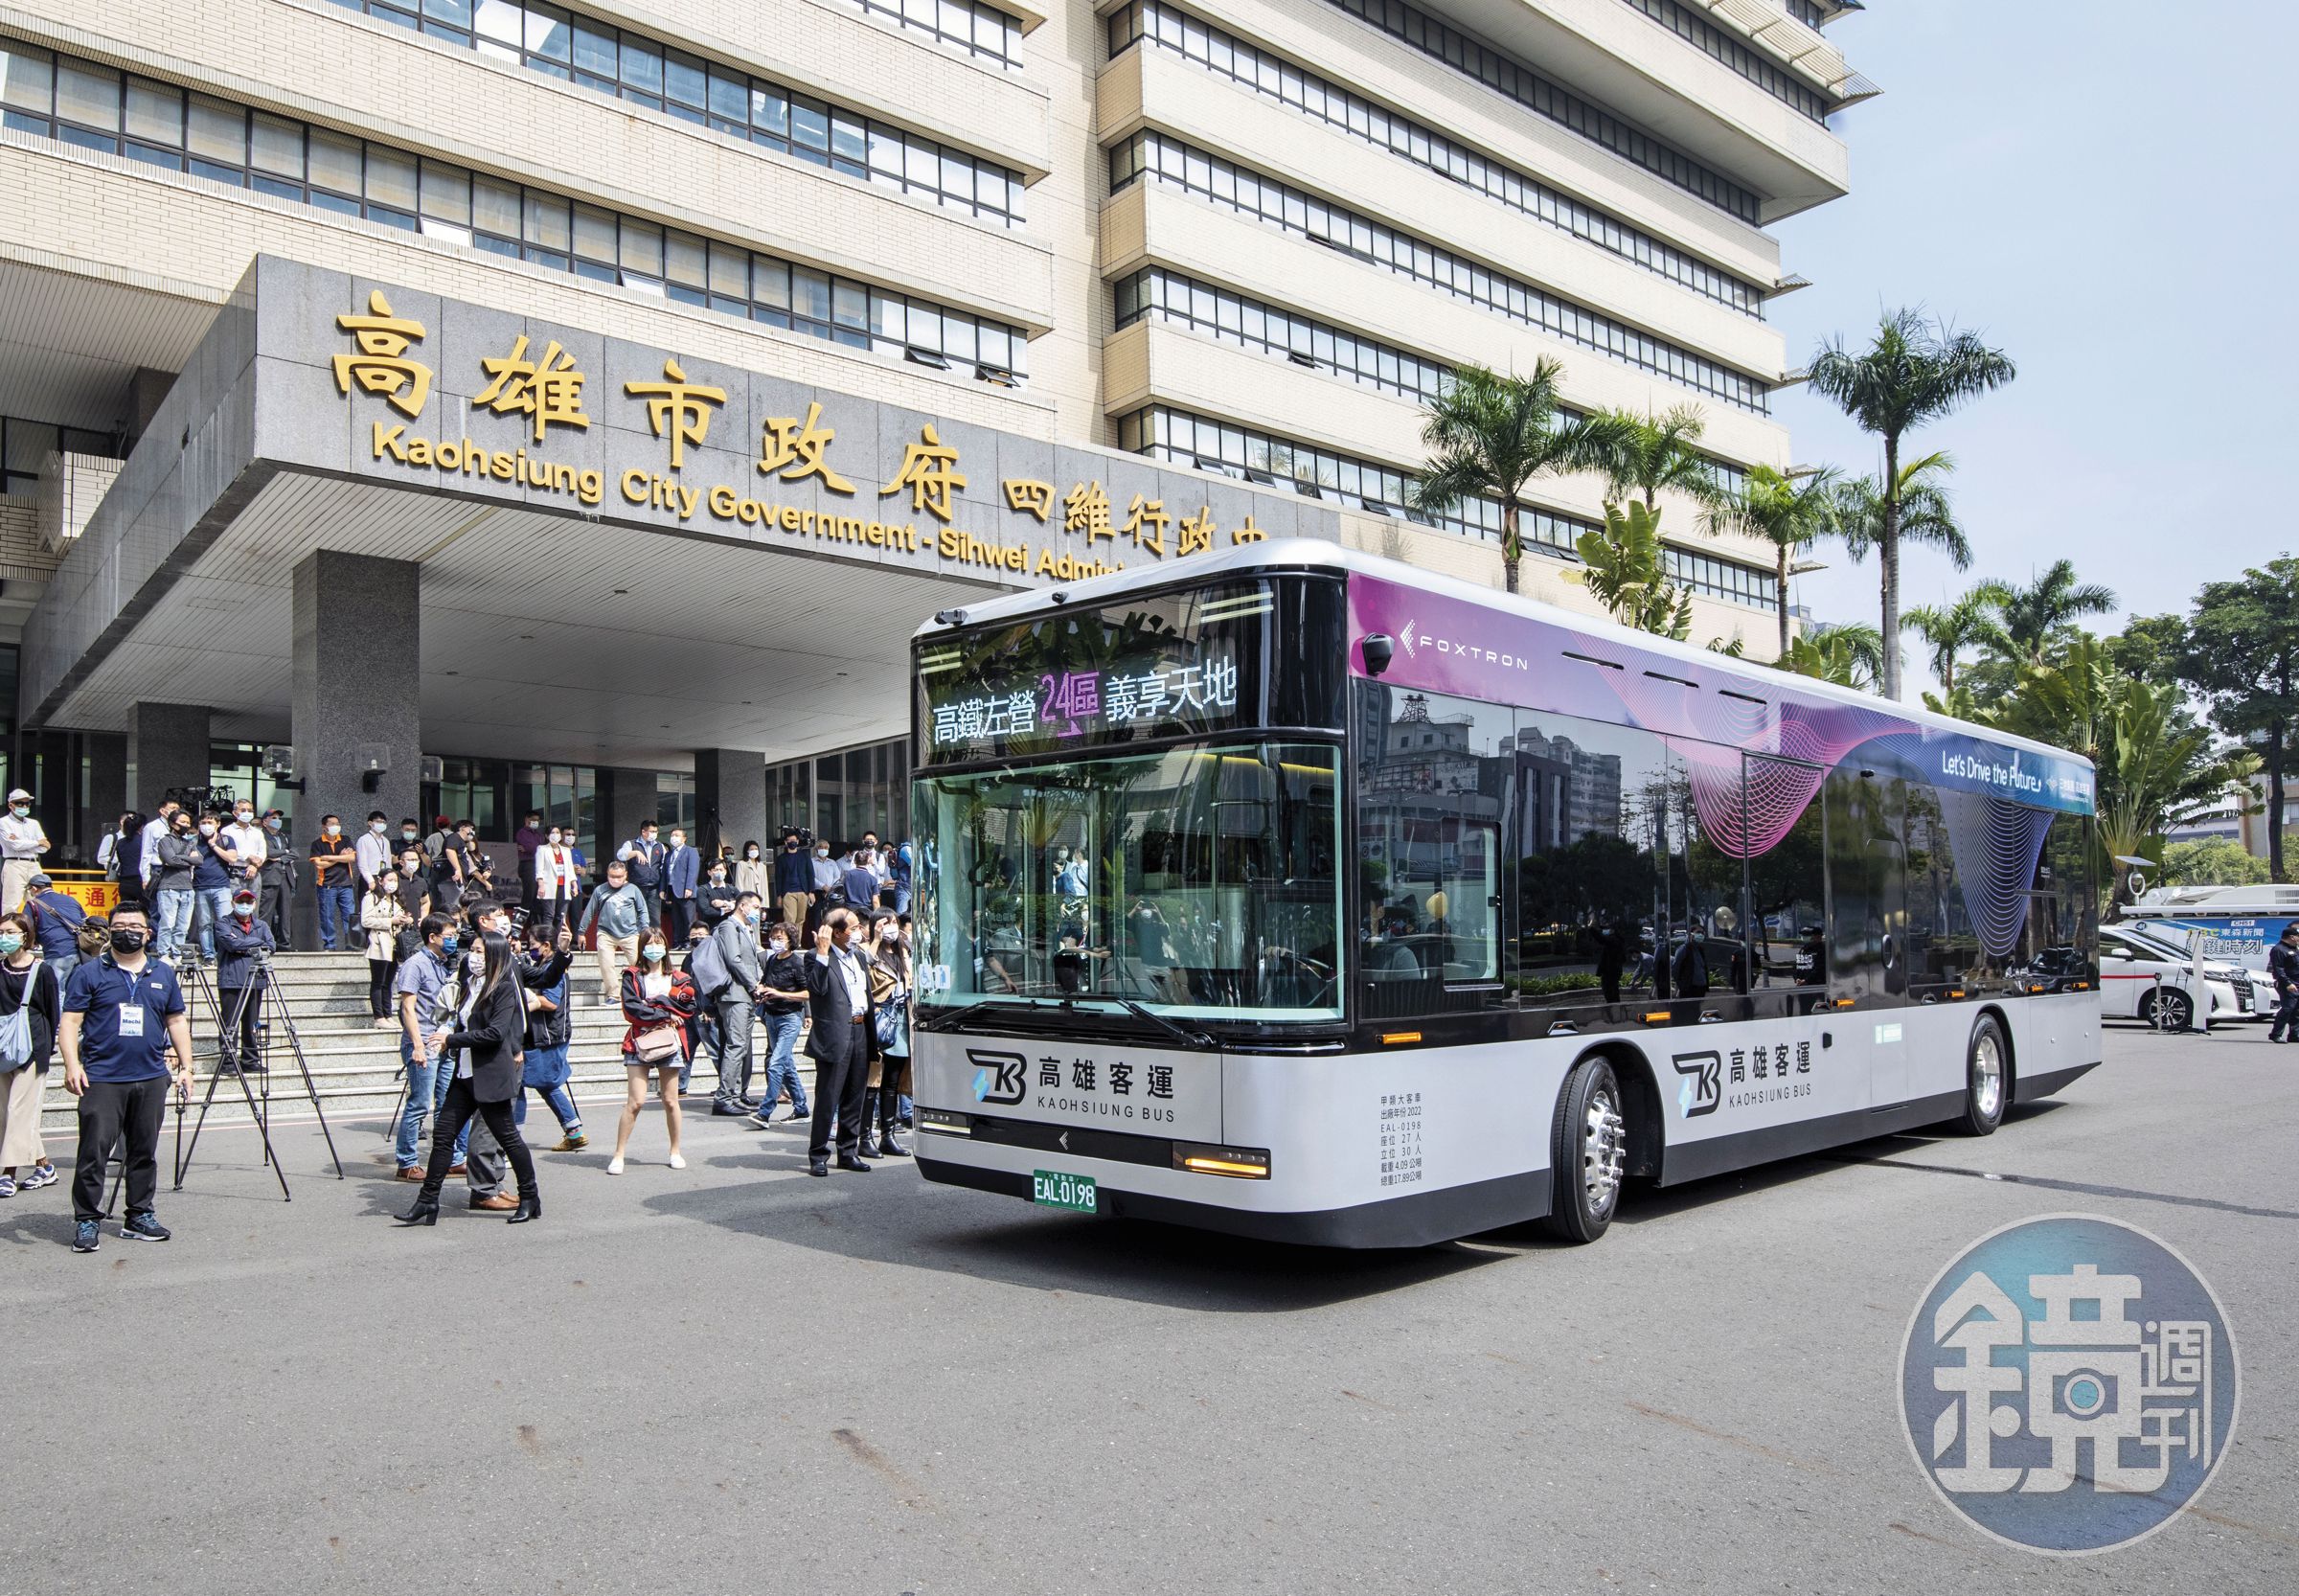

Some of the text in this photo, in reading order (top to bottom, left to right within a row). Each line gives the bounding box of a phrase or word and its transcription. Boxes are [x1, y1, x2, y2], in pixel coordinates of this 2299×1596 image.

[331, 289, 967, 522] 高雄市政府
[373, 422, 603, 504] Kaohsiung
[622, 469, 700, 518] City
[709, 486, 917, 551] Government
[939, 527, 1029, 570] Sihwei
[1421, 636, 1528, 671] FOXTRON
[933, 656, 1237, 745] 高鐵左營 24區 義享天地
[1943, 750, 1966, 777] Let's
[1968, 756, 1991, 783] Drive
[1992, 764, 2008, 786] the
[2010, 759, 2040, 792] Future
[2221, 928, 2264, 937] 東森新聞
[1038, 1056, 1173, 1100] 高雄客運
[1730, 1041, 1810, 1084] 高雄客運
[1037, 1096, 1174, 1123] KAOHSIUNG BUS
[1407, 1106, 1422, 1117] 2022
[1729, 1083, 1811, 1108] KAOHSIUNG BUS
[1381, 1121, 1421, 1132] EAL-0198
